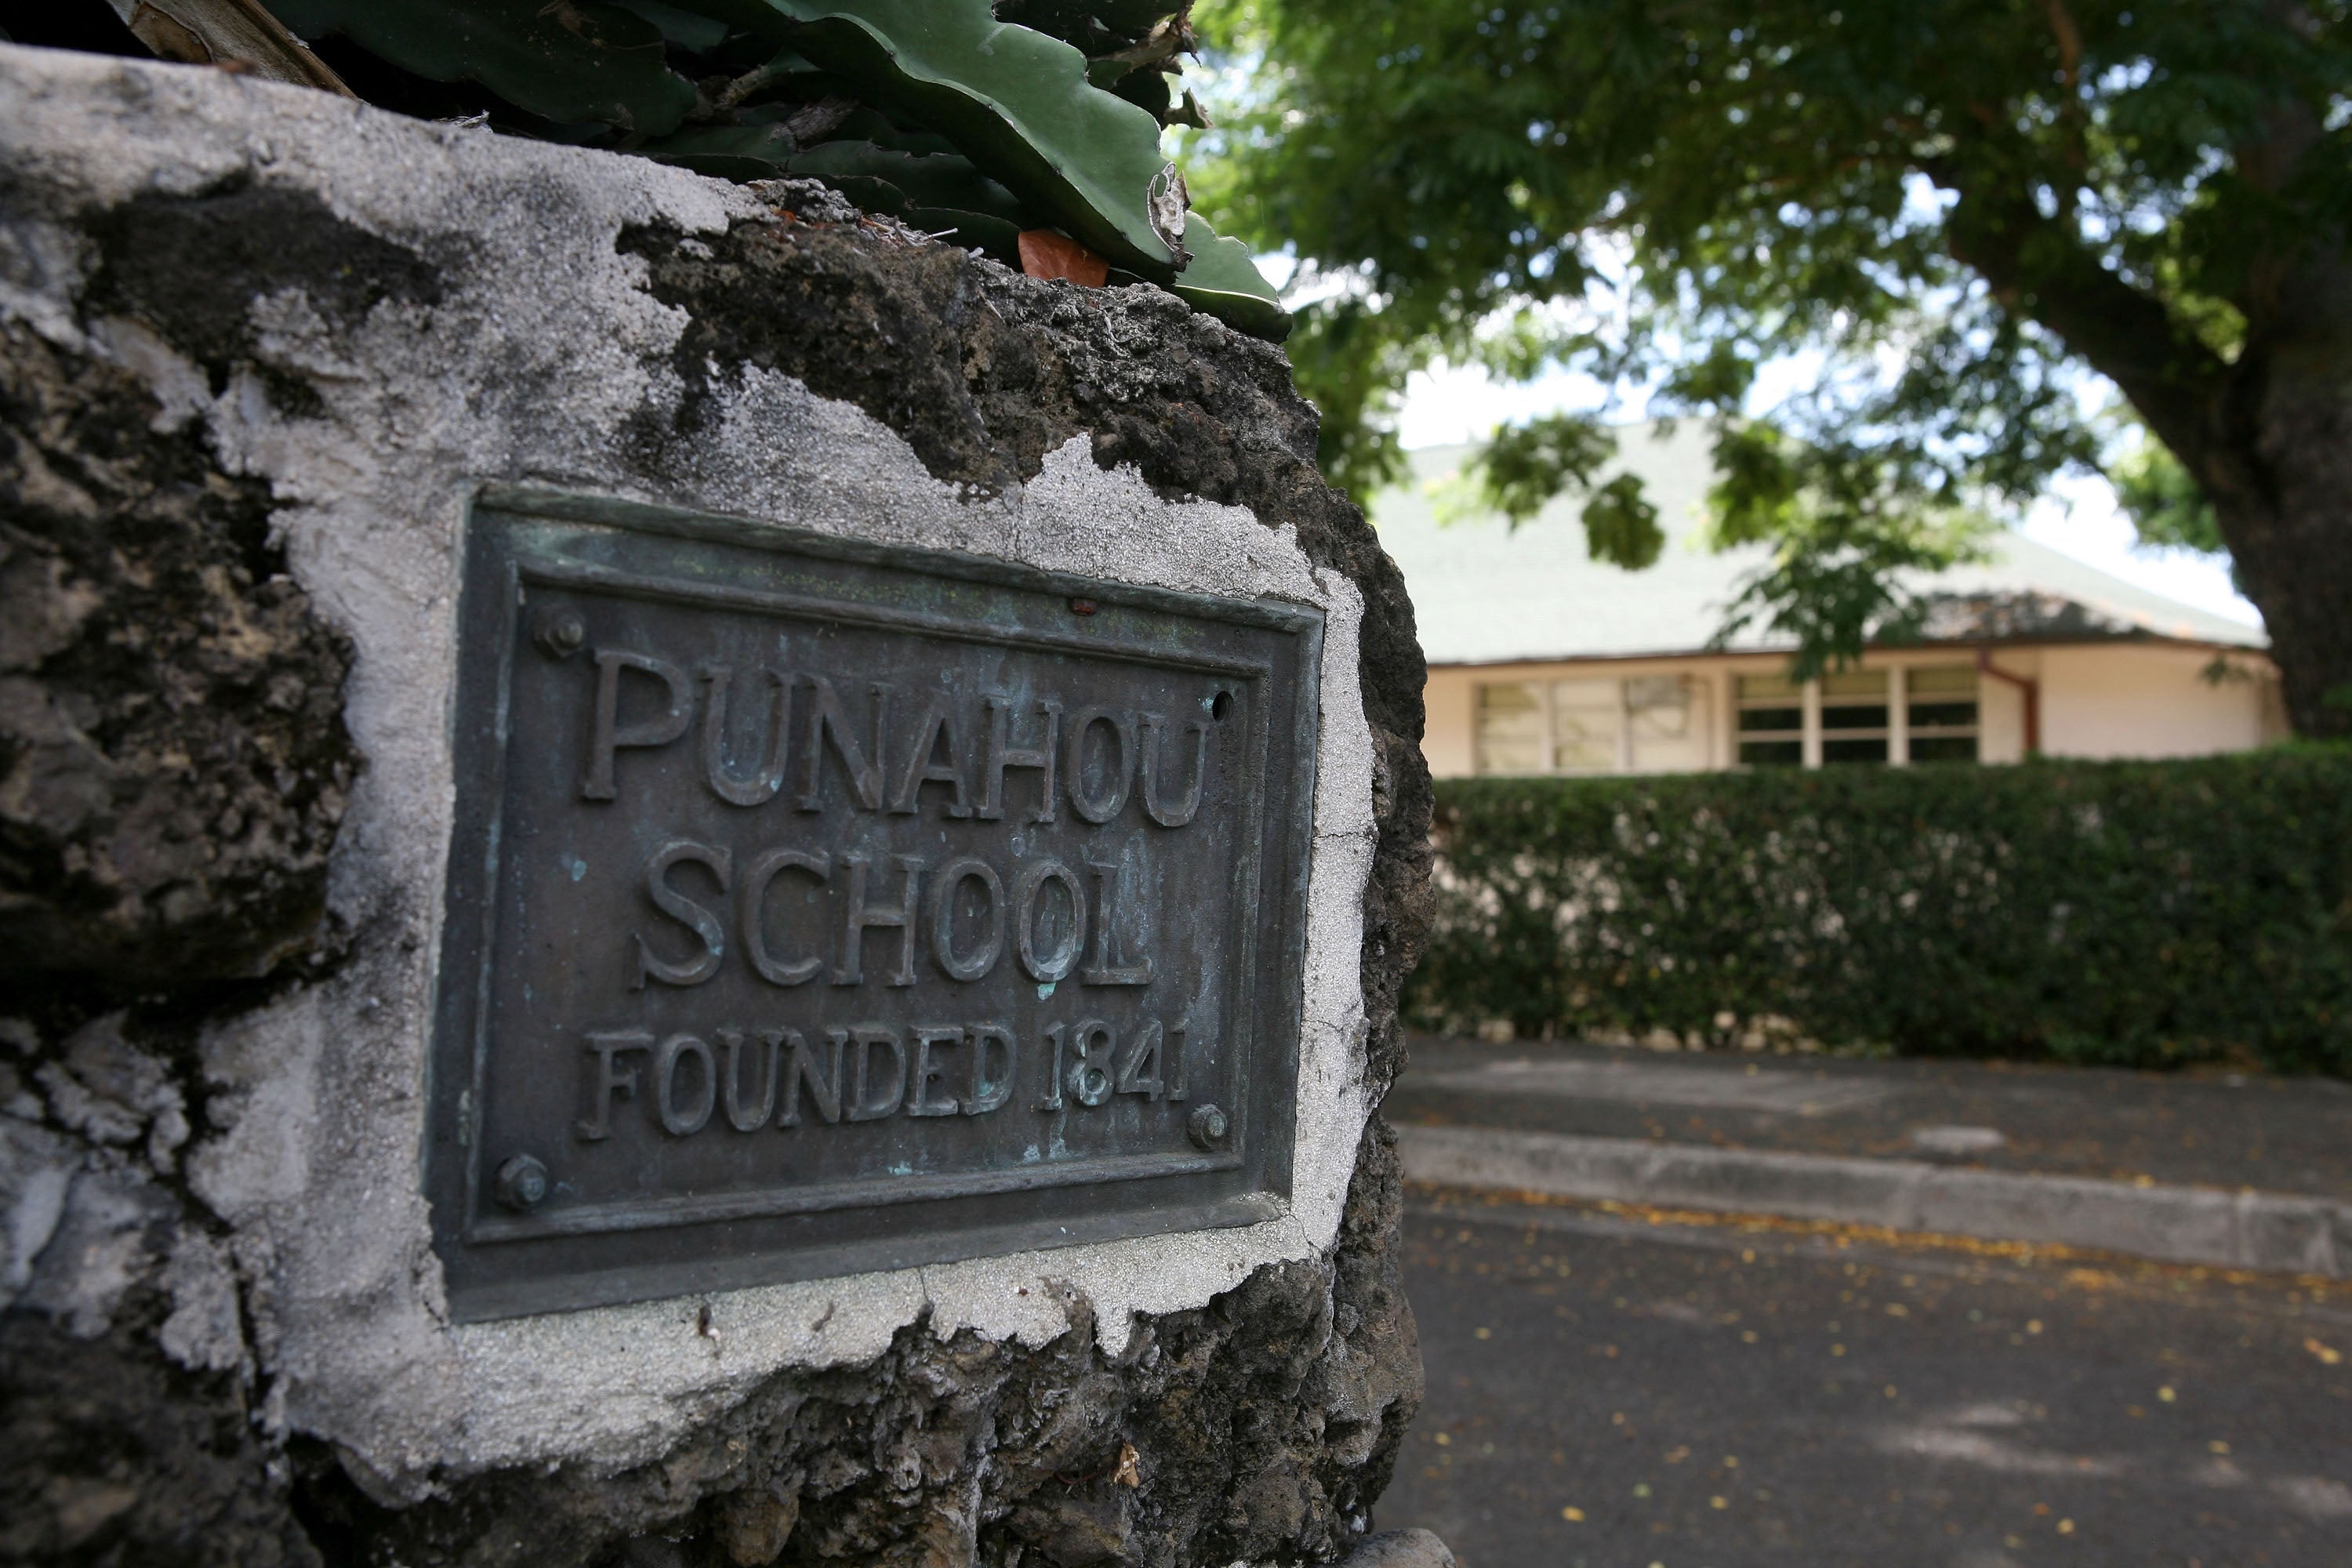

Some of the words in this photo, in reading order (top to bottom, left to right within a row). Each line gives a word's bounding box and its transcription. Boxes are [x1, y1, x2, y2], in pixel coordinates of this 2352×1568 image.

[581, 648, 1210, 827] PUNAHOU
[631, 838, 1153, 989] SCHOOL
[578, 1022, 1017, 1140] FOUNDED
[1041, 1018, 1191, 1110] 1841
